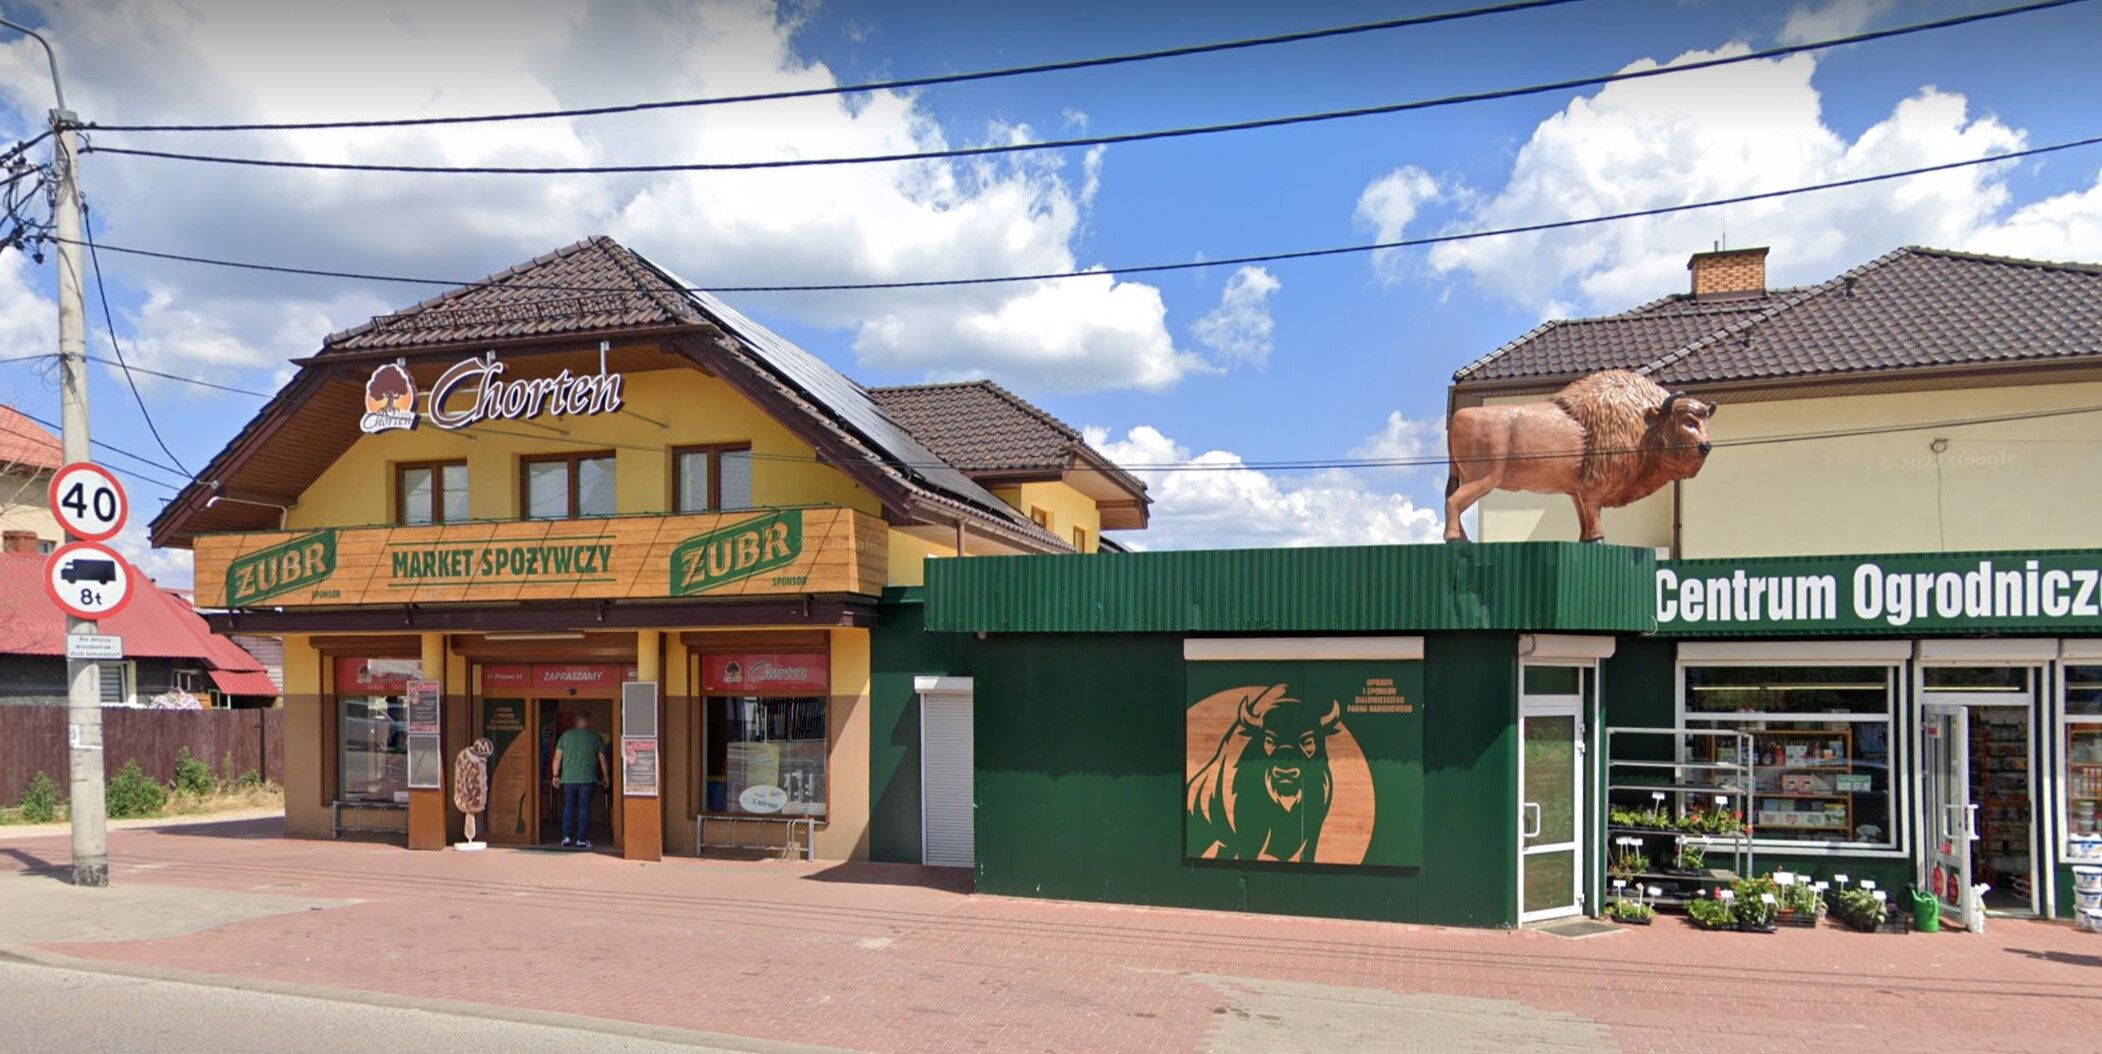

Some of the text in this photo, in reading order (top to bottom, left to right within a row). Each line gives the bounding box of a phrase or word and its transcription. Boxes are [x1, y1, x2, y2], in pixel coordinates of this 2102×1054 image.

[429, 357, 622, 429] Chorten
[62, 482, 116, 523] 40
[392, 544, 612, 577] MARKET SPOŻYWCZY
[772, 575, 807, 586] SPONSOR
[1656, 560, 2102, 626] Centrum Ogrodnicz
